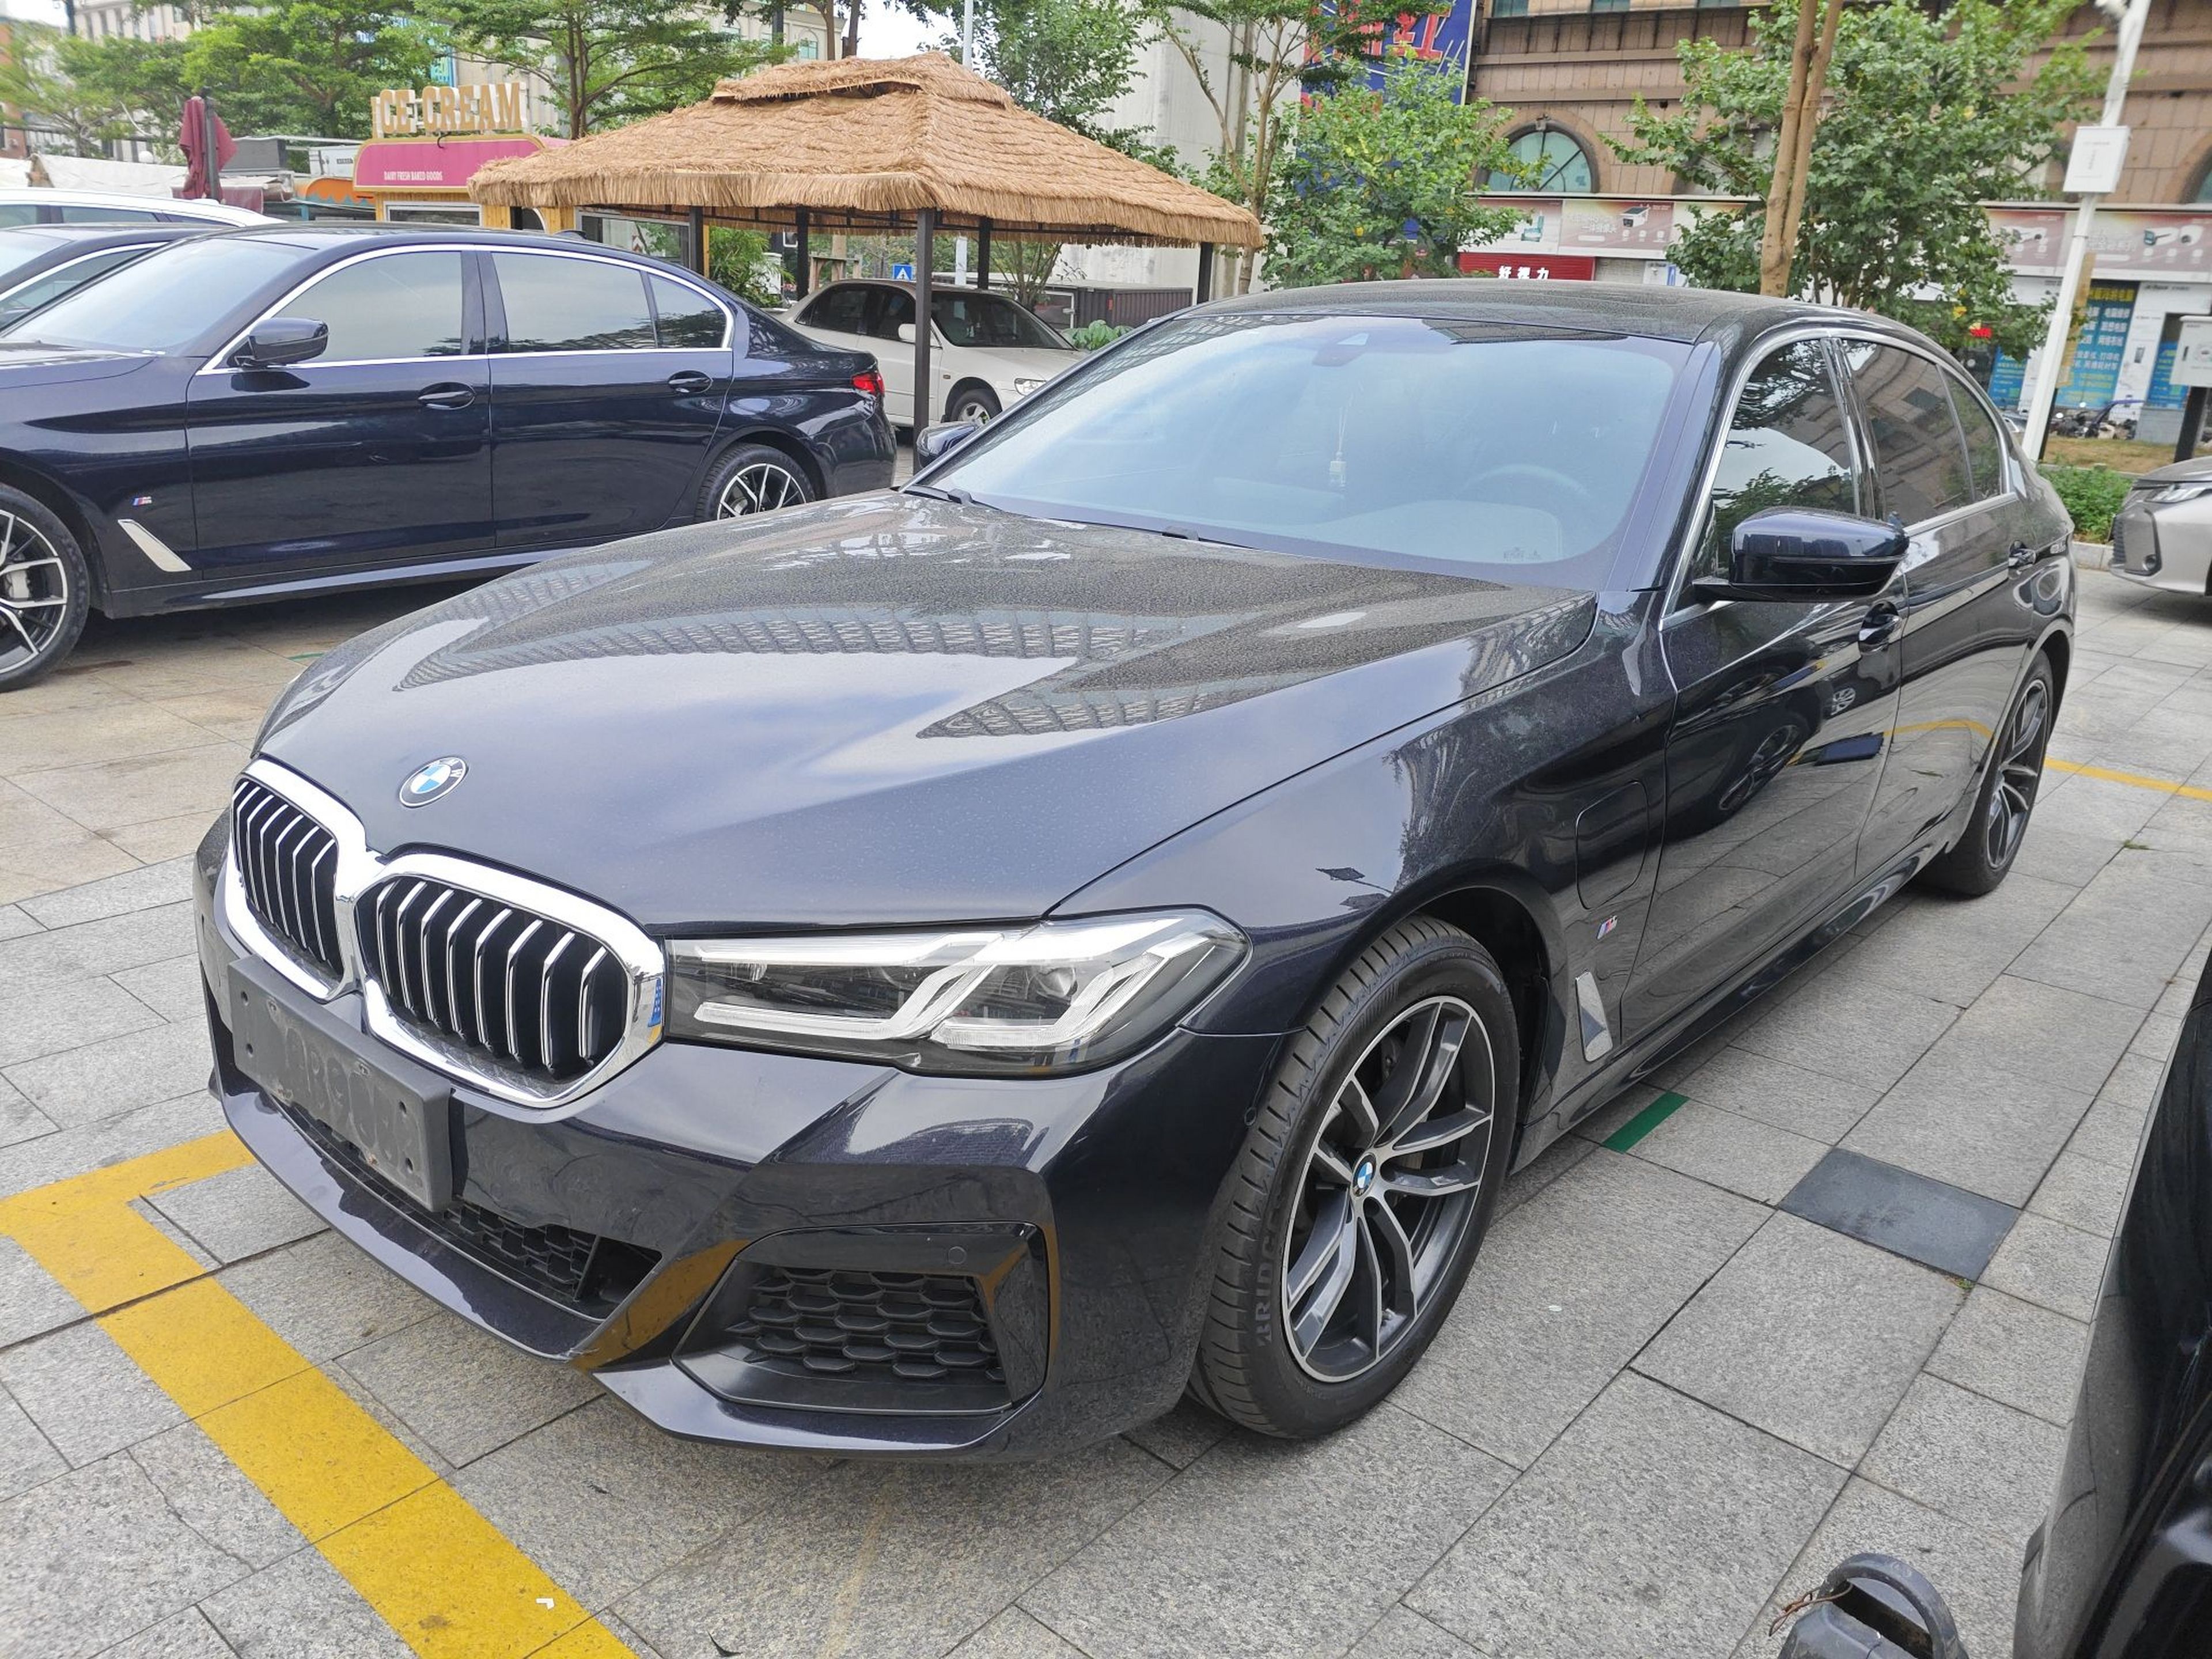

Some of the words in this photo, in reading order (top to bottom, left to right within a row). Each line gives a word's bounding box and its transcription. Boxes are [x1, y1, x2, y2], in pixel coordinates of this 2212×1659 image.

[370, 89, 417, 138] ICE
[422, 82, 525, 132] CREAM
[397, 171, 411, 180] FRESH
[411, 171, 425, 181] BAKED
[426, 171, 443, 181] GOODS
